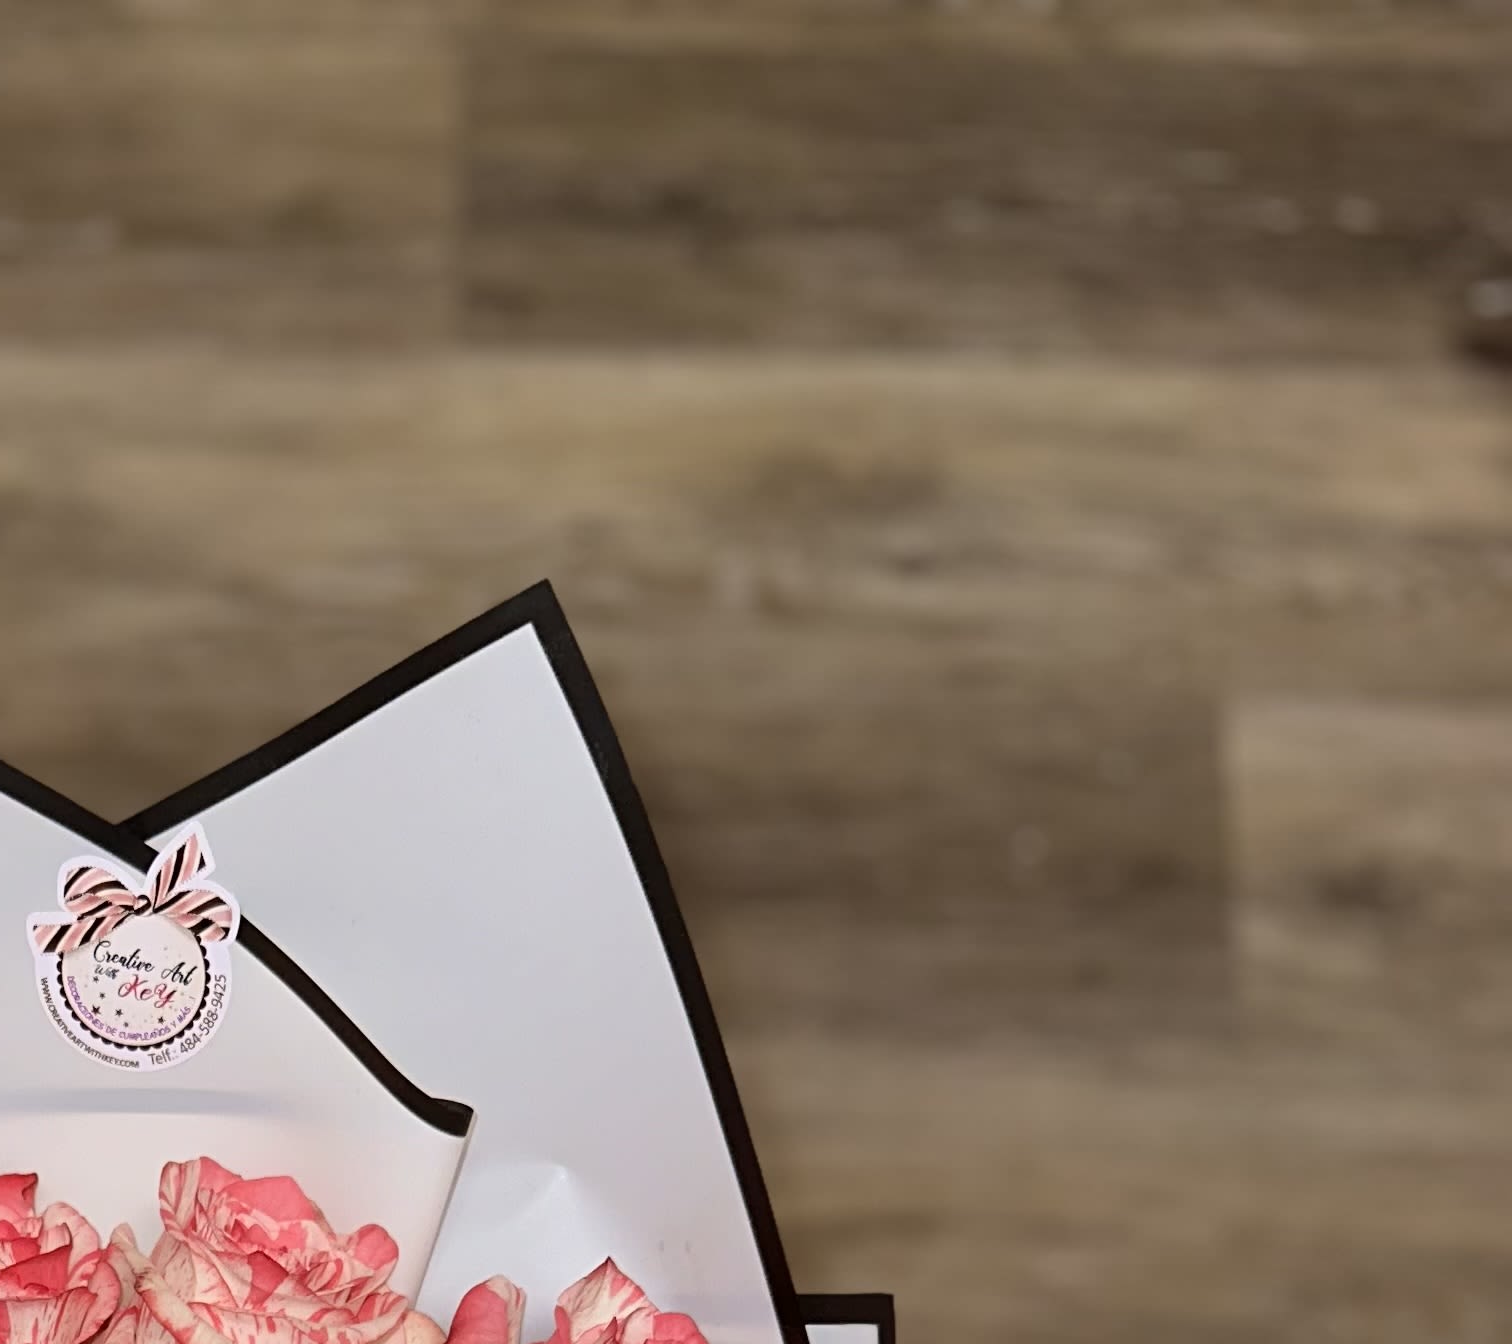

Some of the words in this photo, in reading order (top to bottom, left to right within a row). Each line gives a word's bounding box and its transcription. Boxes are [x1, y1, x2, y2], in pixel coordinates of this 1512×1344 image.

[94, 941, 154, 972] Creative
[161, 962, 198, 986] Art
[118, 973, 177, 1009] Key
[179, 973, 228, 1055] 484-588-9425
